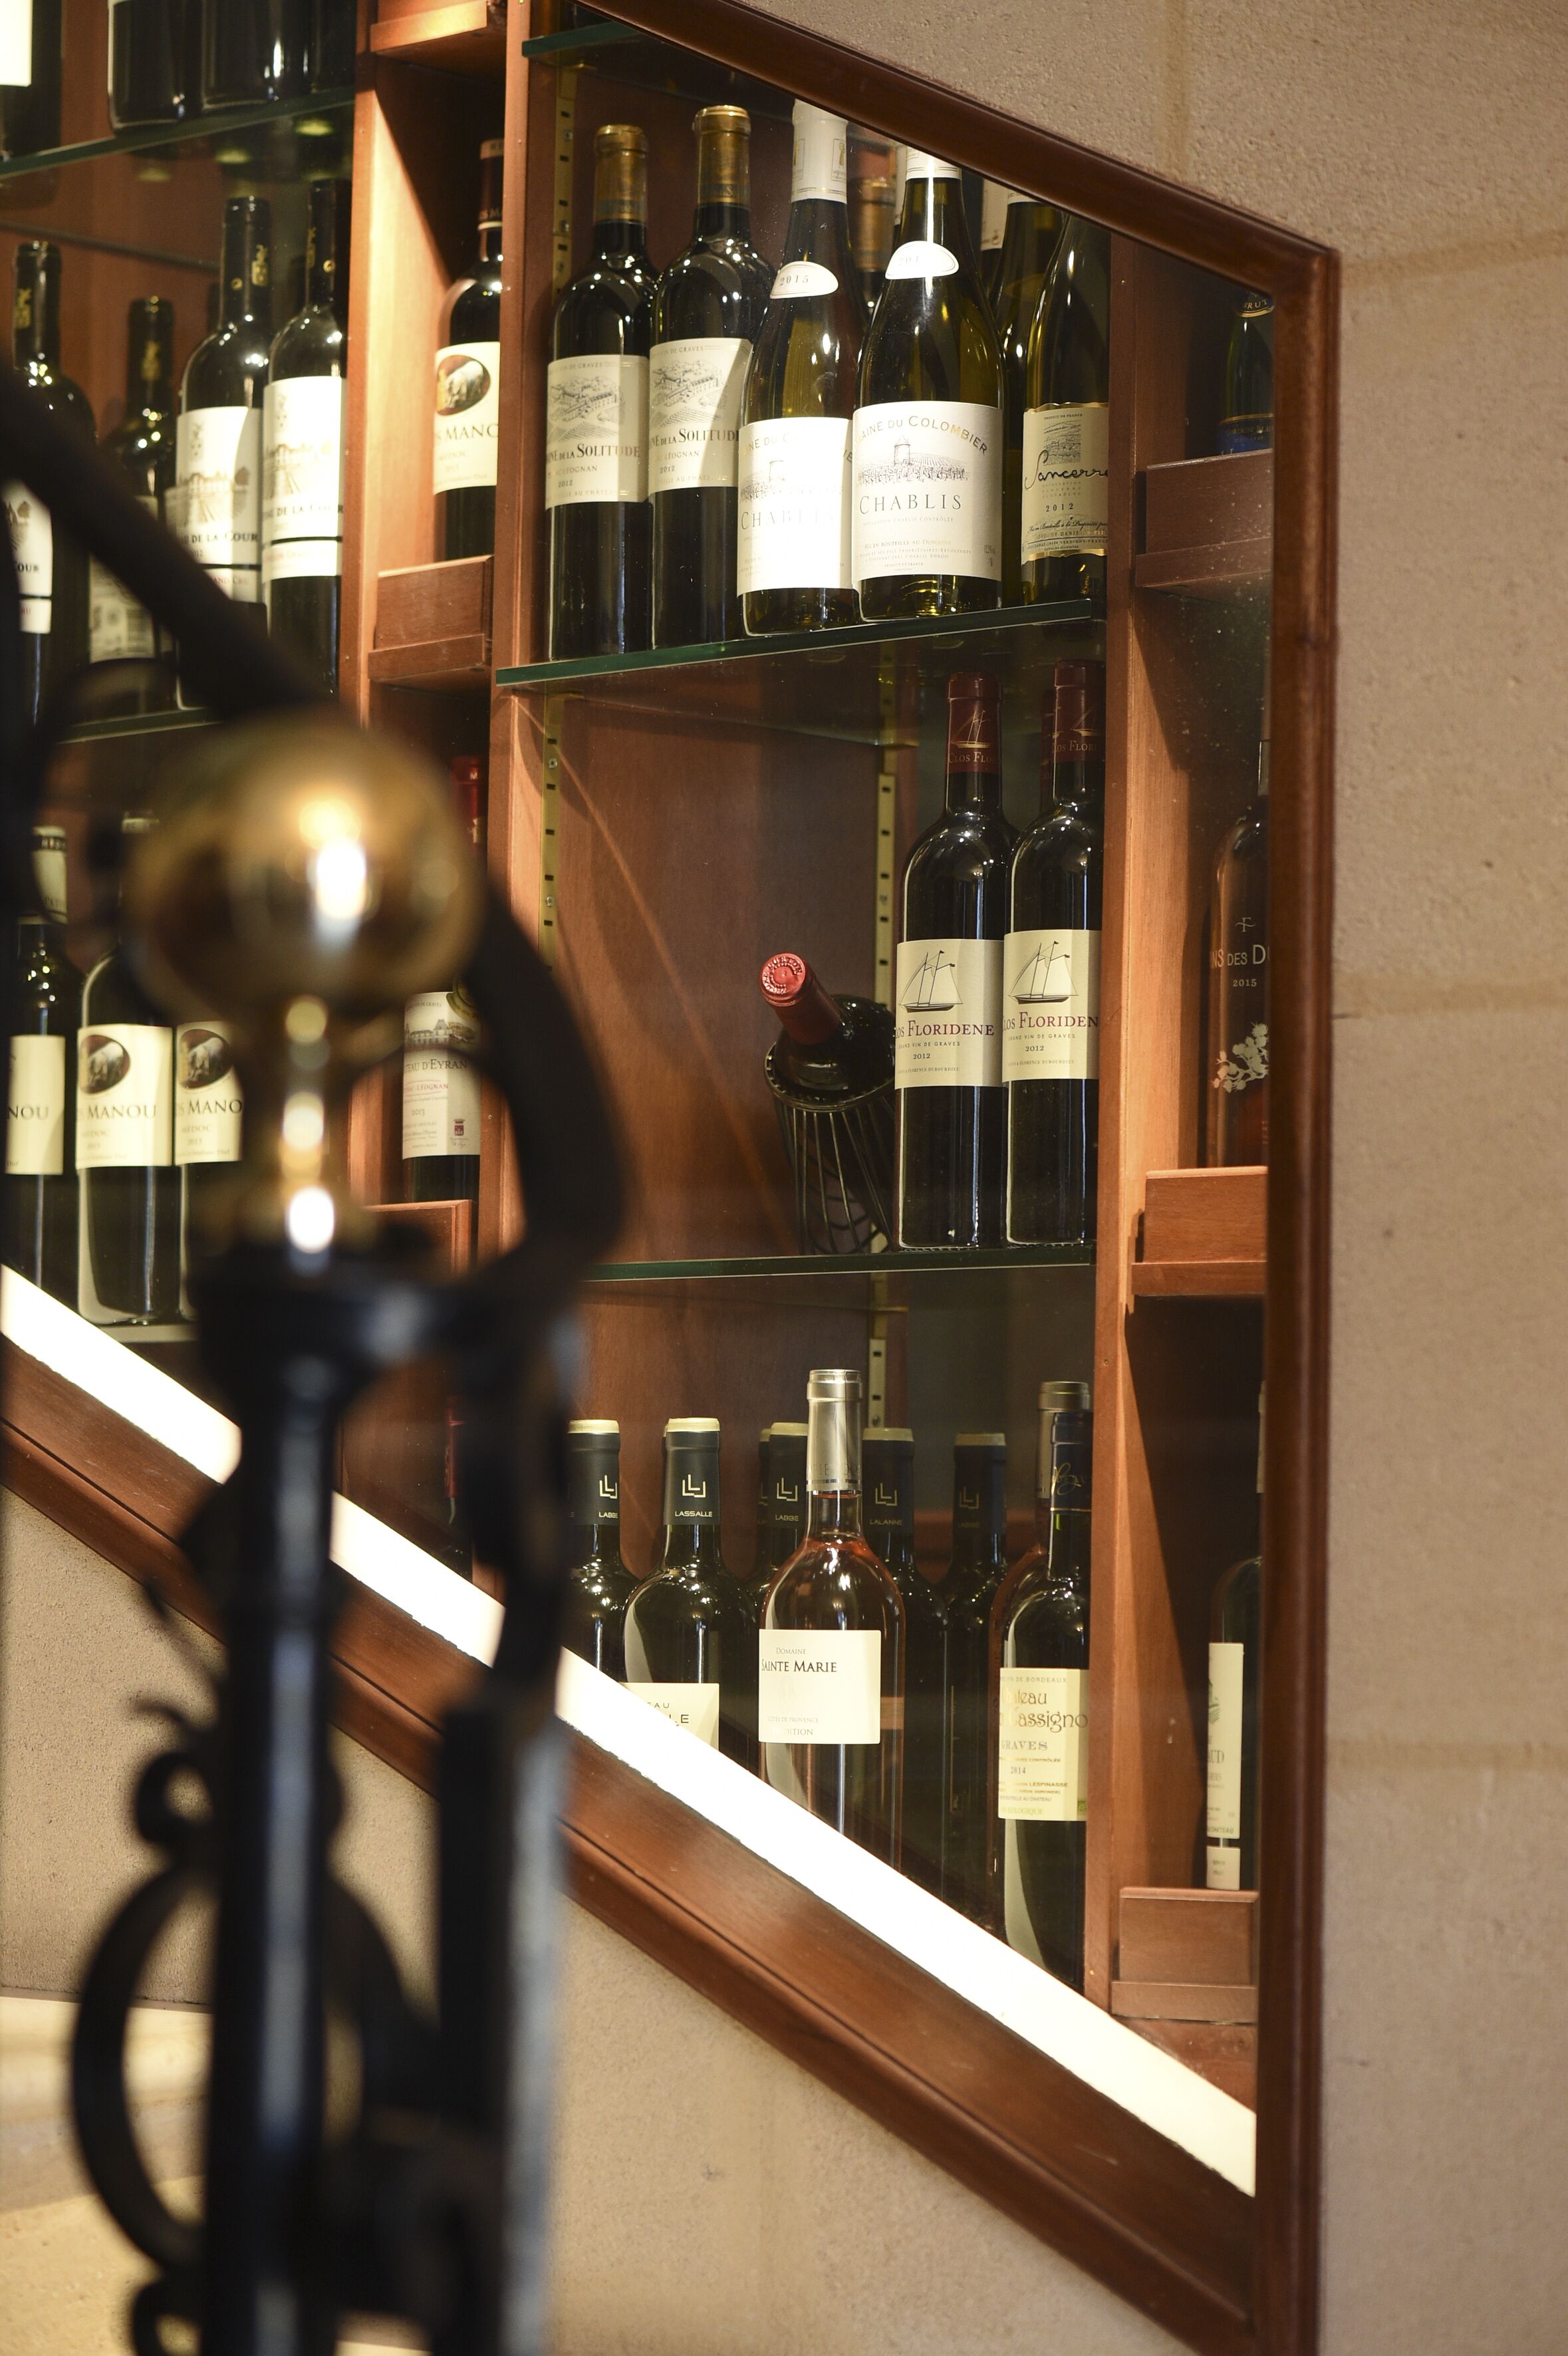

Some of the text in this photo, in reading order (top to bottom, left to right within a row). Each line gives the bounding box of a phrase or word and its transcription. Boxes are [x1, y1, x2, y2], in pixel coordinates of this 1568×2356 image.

[1244, 299, 1269, 309] RUT
[888, 419, 903, 429] DU
[908, 415, 987, 456] COLOMBIER
[558, 479, 573, 488] 2012
[859, 494, 962, 515] CHABLIS
[1045, 503, 1074, 512] 2012
[1227, 952, 1248, 967] DES
[1232, 979, 1257, 988] 2015
[907, 1019, 995, 1037] FLORIDENE
[86, 1104, 158, 1120] MANOU
[761, 1658, 837, 1672] SAINTE MARIE
[1001, 1740, 1048, 1750] GRAVES
[1010, 1766, 1026, 1775] 2014
